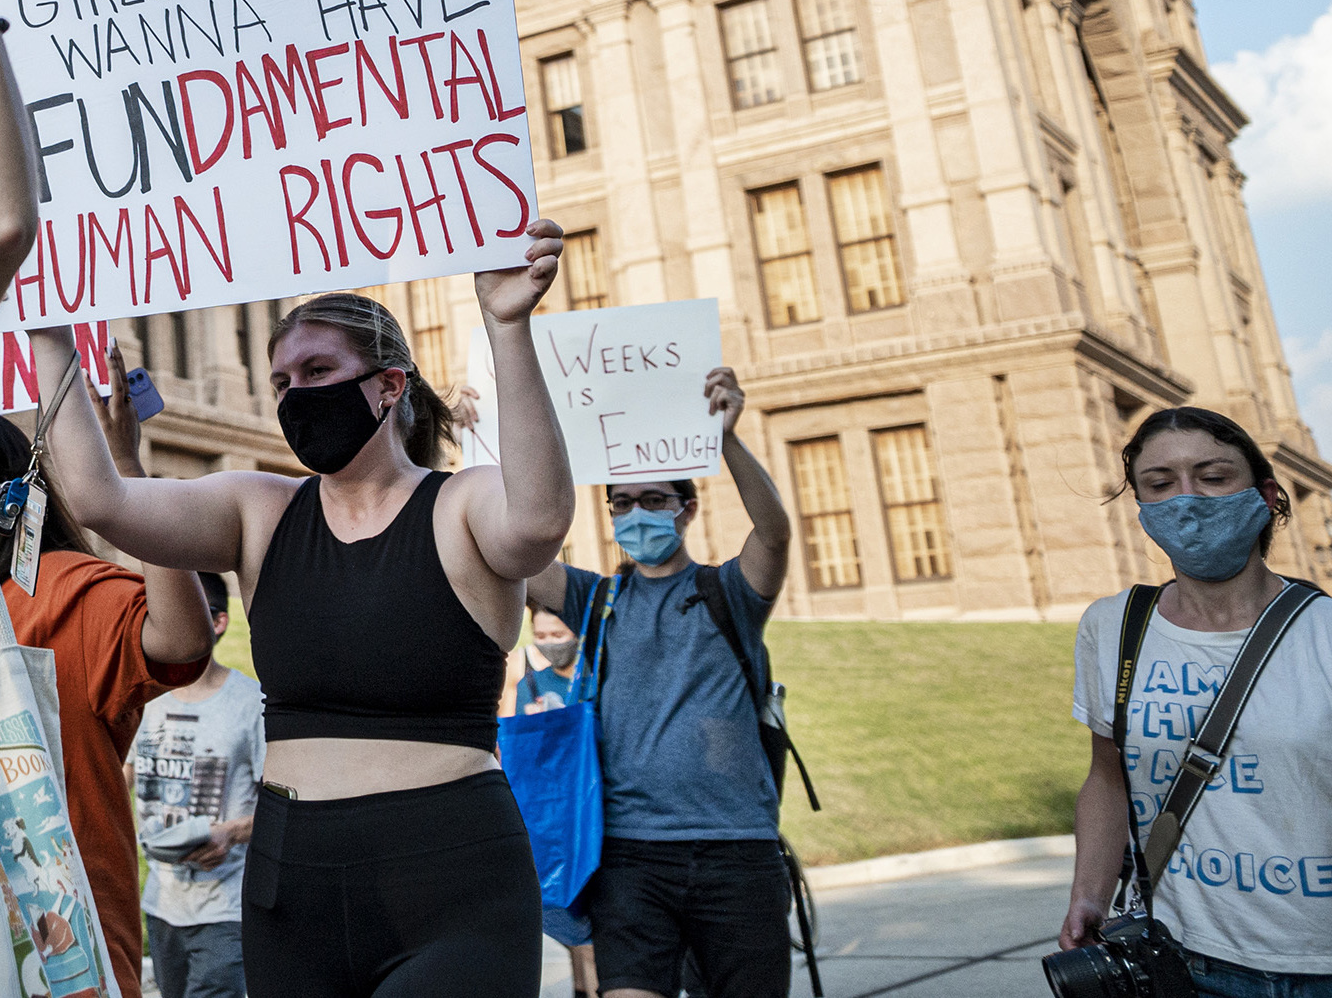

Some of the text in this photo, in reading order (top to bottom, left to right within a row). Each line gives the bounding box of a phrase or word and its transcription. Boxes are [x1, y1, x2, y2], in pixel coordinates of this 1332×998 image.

[25, 28, 526, 203] FUNDAMENTAL
[14, 133, 530, 322] HUMAN RIGHTS
[1117, 659, 1132, 704] Nikon
[1143, 660, 1227, 696] AM
[134, 755, 194, 780] BRONX
[1134, 832, 1332, 898] HOICE
